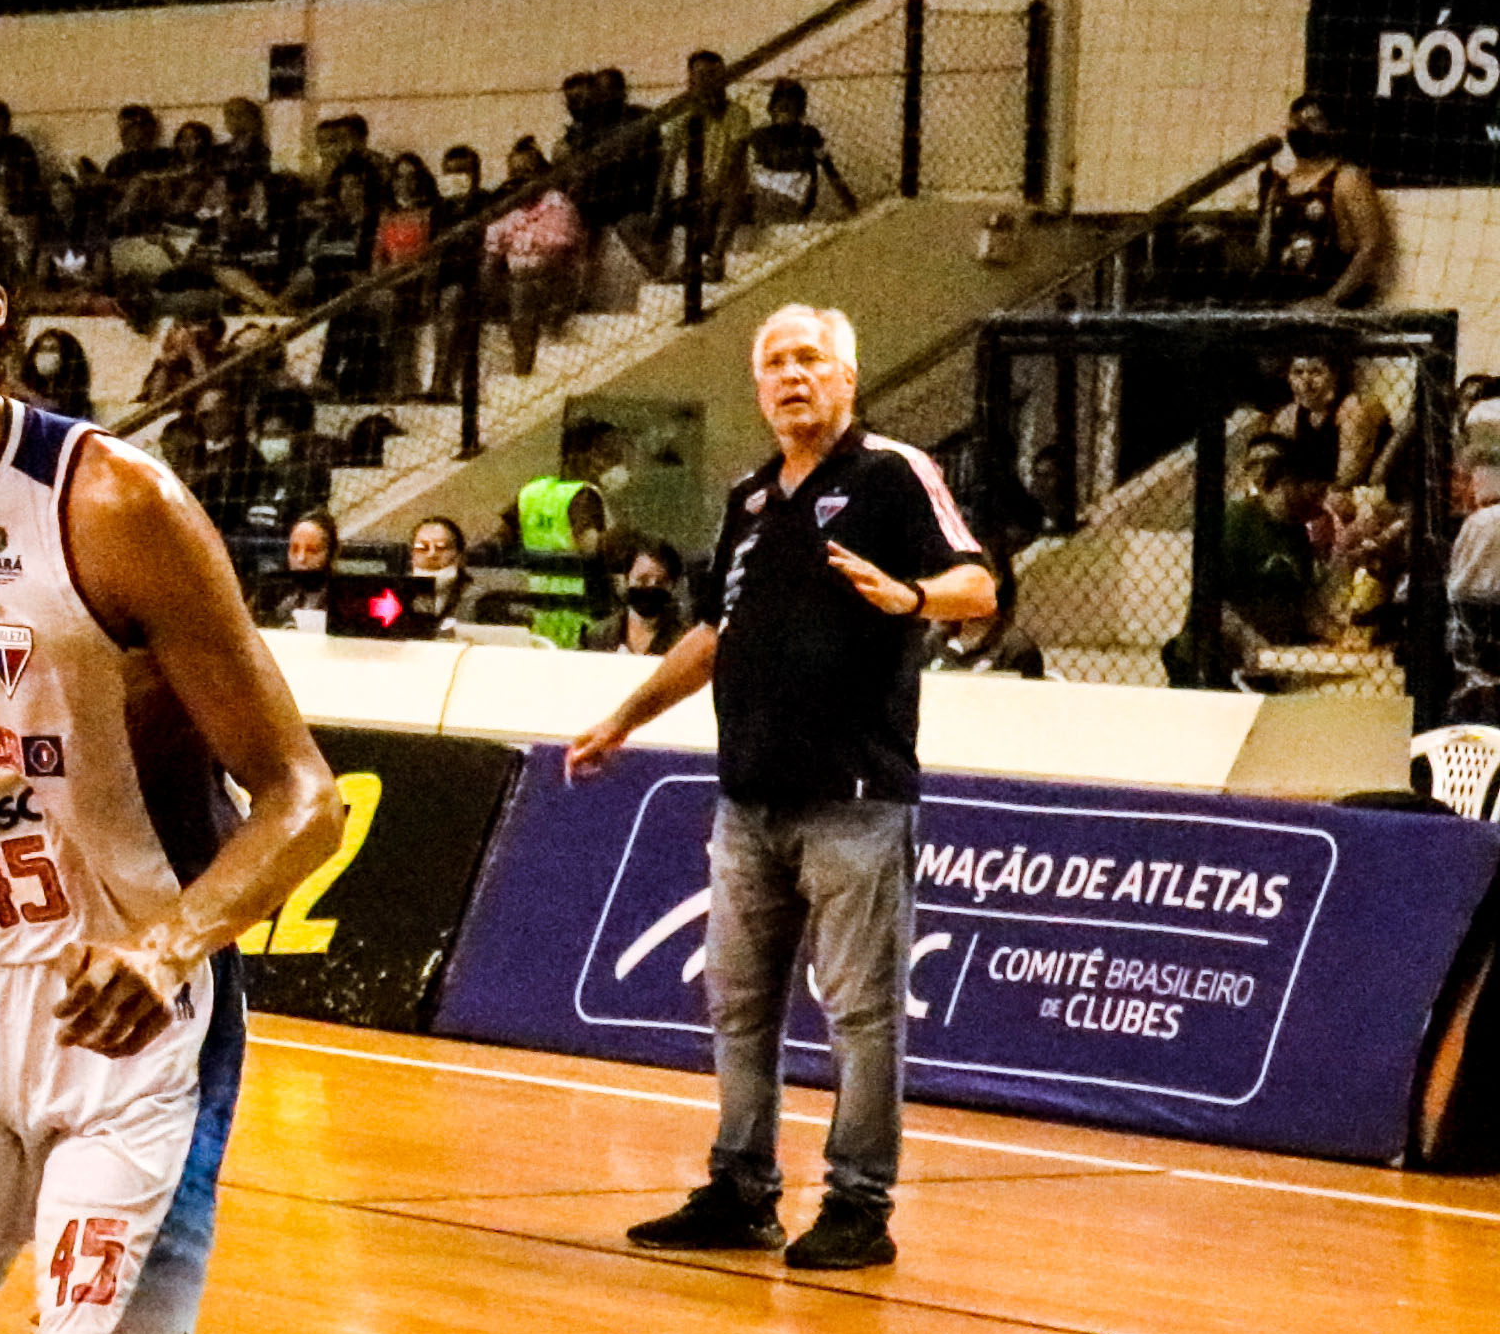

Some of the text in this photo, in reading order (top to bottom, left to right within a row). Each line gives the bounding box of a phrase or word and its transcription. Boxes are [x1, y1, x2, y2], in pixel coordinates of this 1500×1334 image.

[1377, 8, 1500, 98] PÓS
[915, 844, 1289, 919] MAÇÃO DE ATLETAS
[988, 947, 1105, 988] COMITÊ
[1104, 957, 1255, 1007] BRASILEIRO
[1065, 993, 1185, 1040] CLUBES
[51, 1218, 129, 1307] 45
